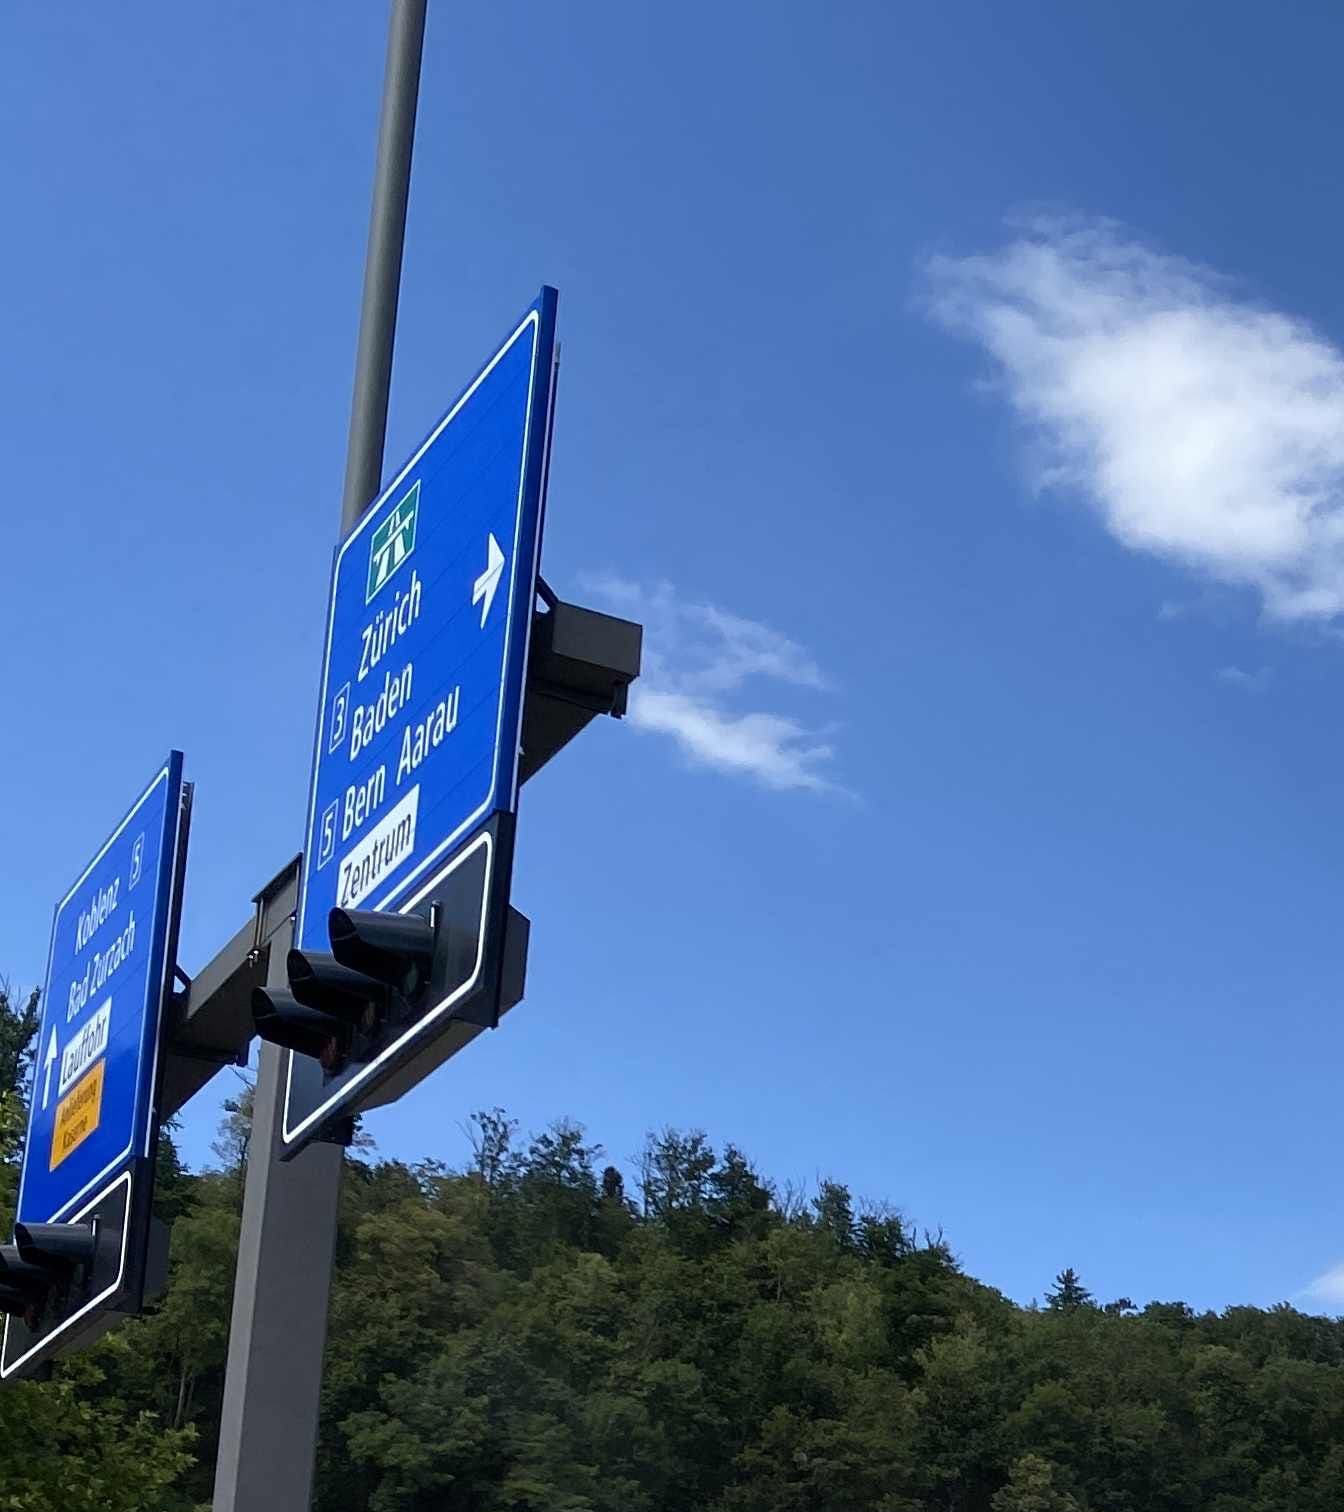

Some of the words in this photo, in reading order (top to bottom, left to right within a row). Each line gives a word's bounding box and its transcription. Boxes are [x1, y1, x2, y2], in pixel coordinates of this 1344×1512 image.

[357, 569, 422, 682] Zürich
[333, 696, 345, 741] 3
[350, 662, 413, 762] Baden
[322, 812, 333, 858] 5
[342, 764, 386, 842] Bern
[397, 685, 460, 786] Aarau
[75, 877, 120, 955] Koblenz
[133, 843, 141, 880] 5
[340, 813, 412, 906] Zentrum
[66, 961, 91, 1023] Bad
[90, 910, 136, 997] Zurzach
[62, 1014, 107, 1085] Lauffohr
